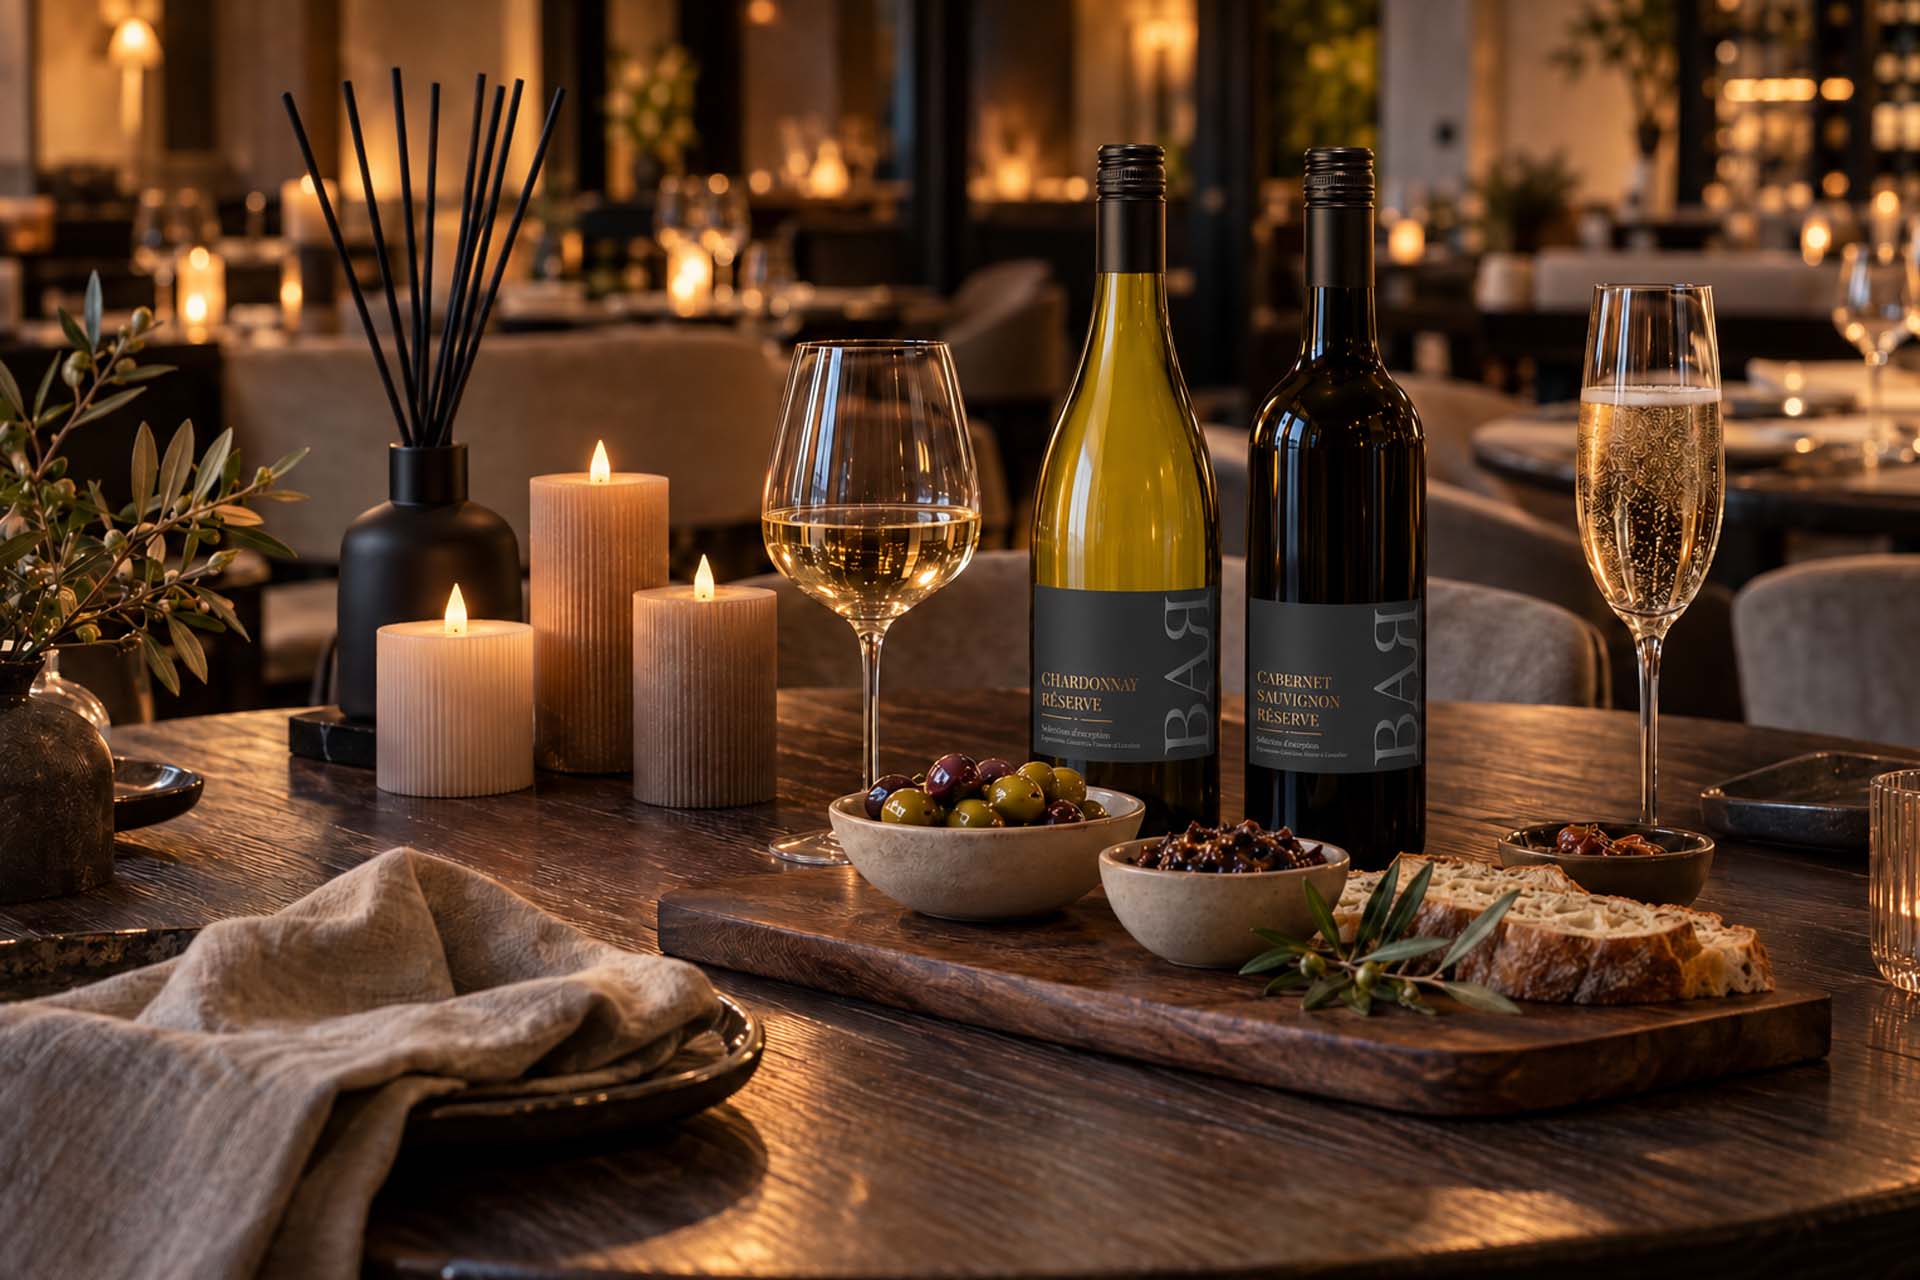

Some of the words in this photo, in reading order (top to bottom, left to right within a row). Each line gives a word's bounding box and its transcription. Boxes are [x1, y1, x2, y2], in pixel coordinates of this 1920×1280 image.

[1041, 672, 1138, 692] CHARDONNAY
[1257, 671, 1332, 689] CABERNET
[1042, 690, 1102, 712] RÉSERVE
[1257, 689, 1340, 708] SAUVIGNON
[1257, 707, 1320, 727] RÉSERVE
